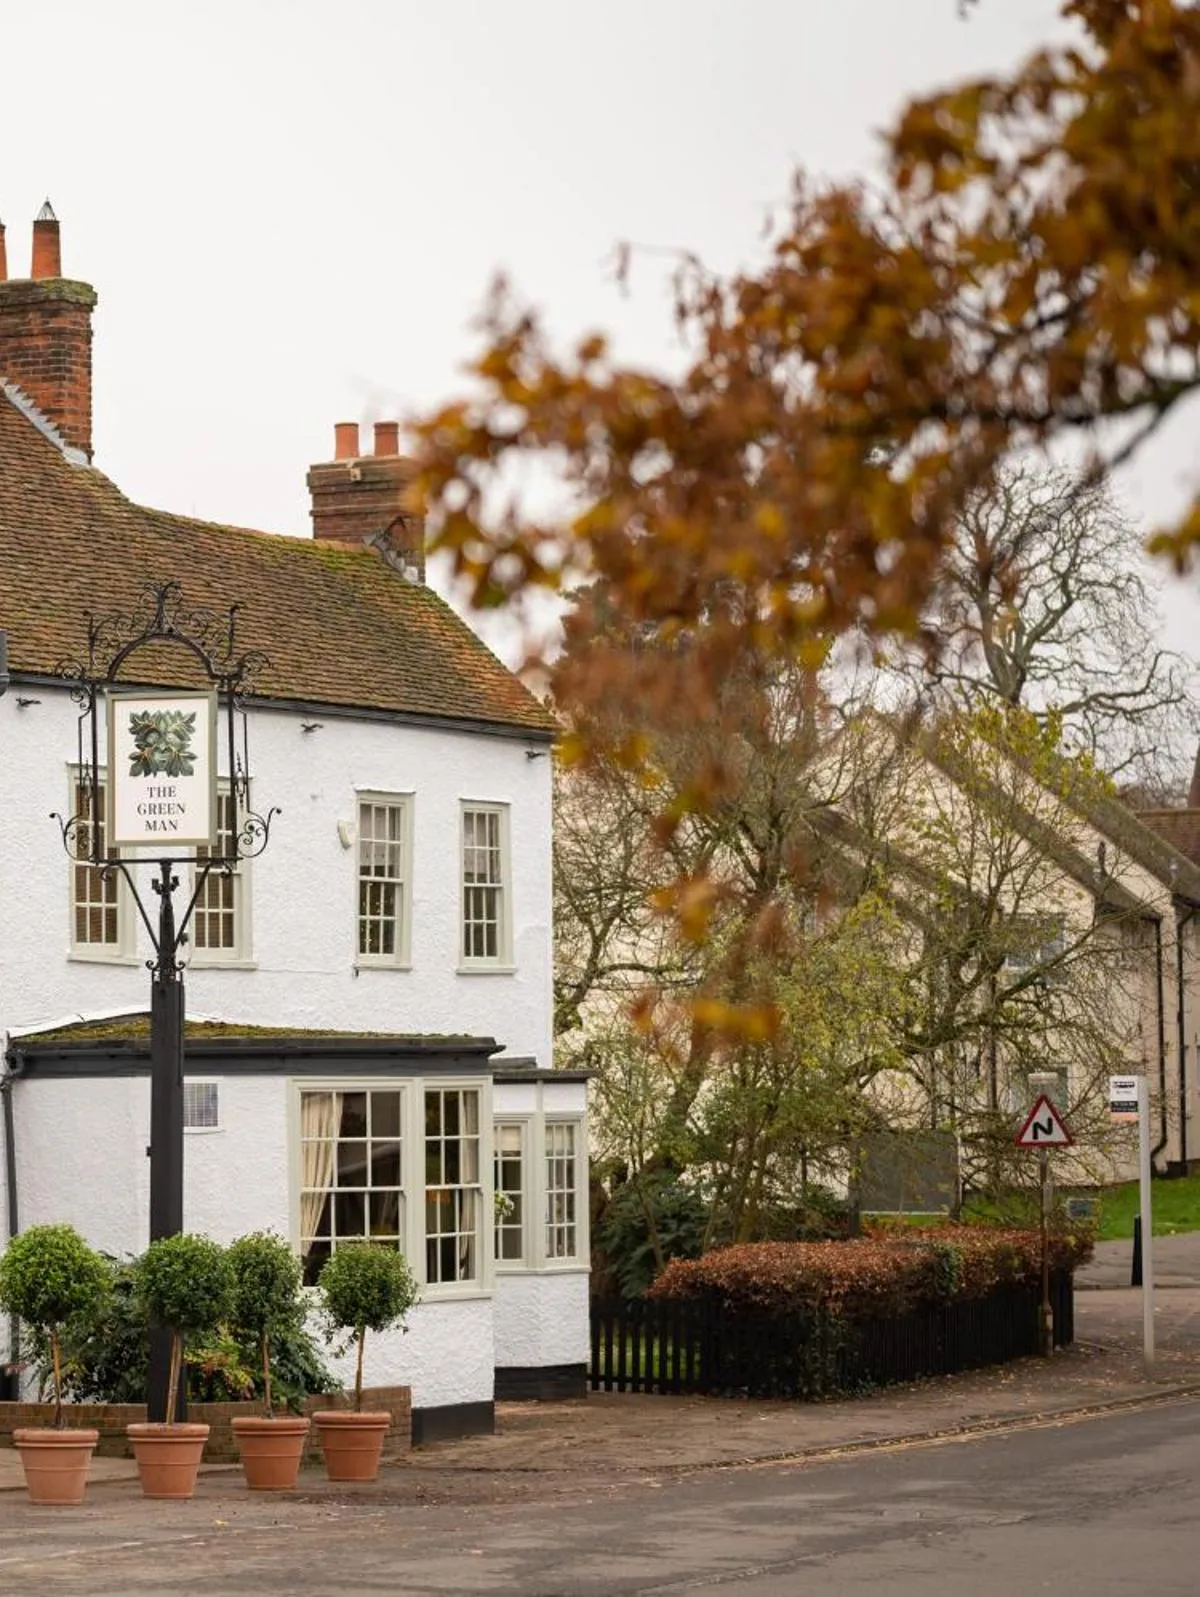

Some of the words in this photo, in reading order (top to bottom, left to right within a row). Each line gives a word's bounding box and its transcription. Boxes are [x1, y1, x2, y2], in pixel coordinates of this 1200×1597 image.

[147, 786, 176, 798] THE
[137, 803, 185, 815] GREEN
[144, 820, 178, 831] MAN
